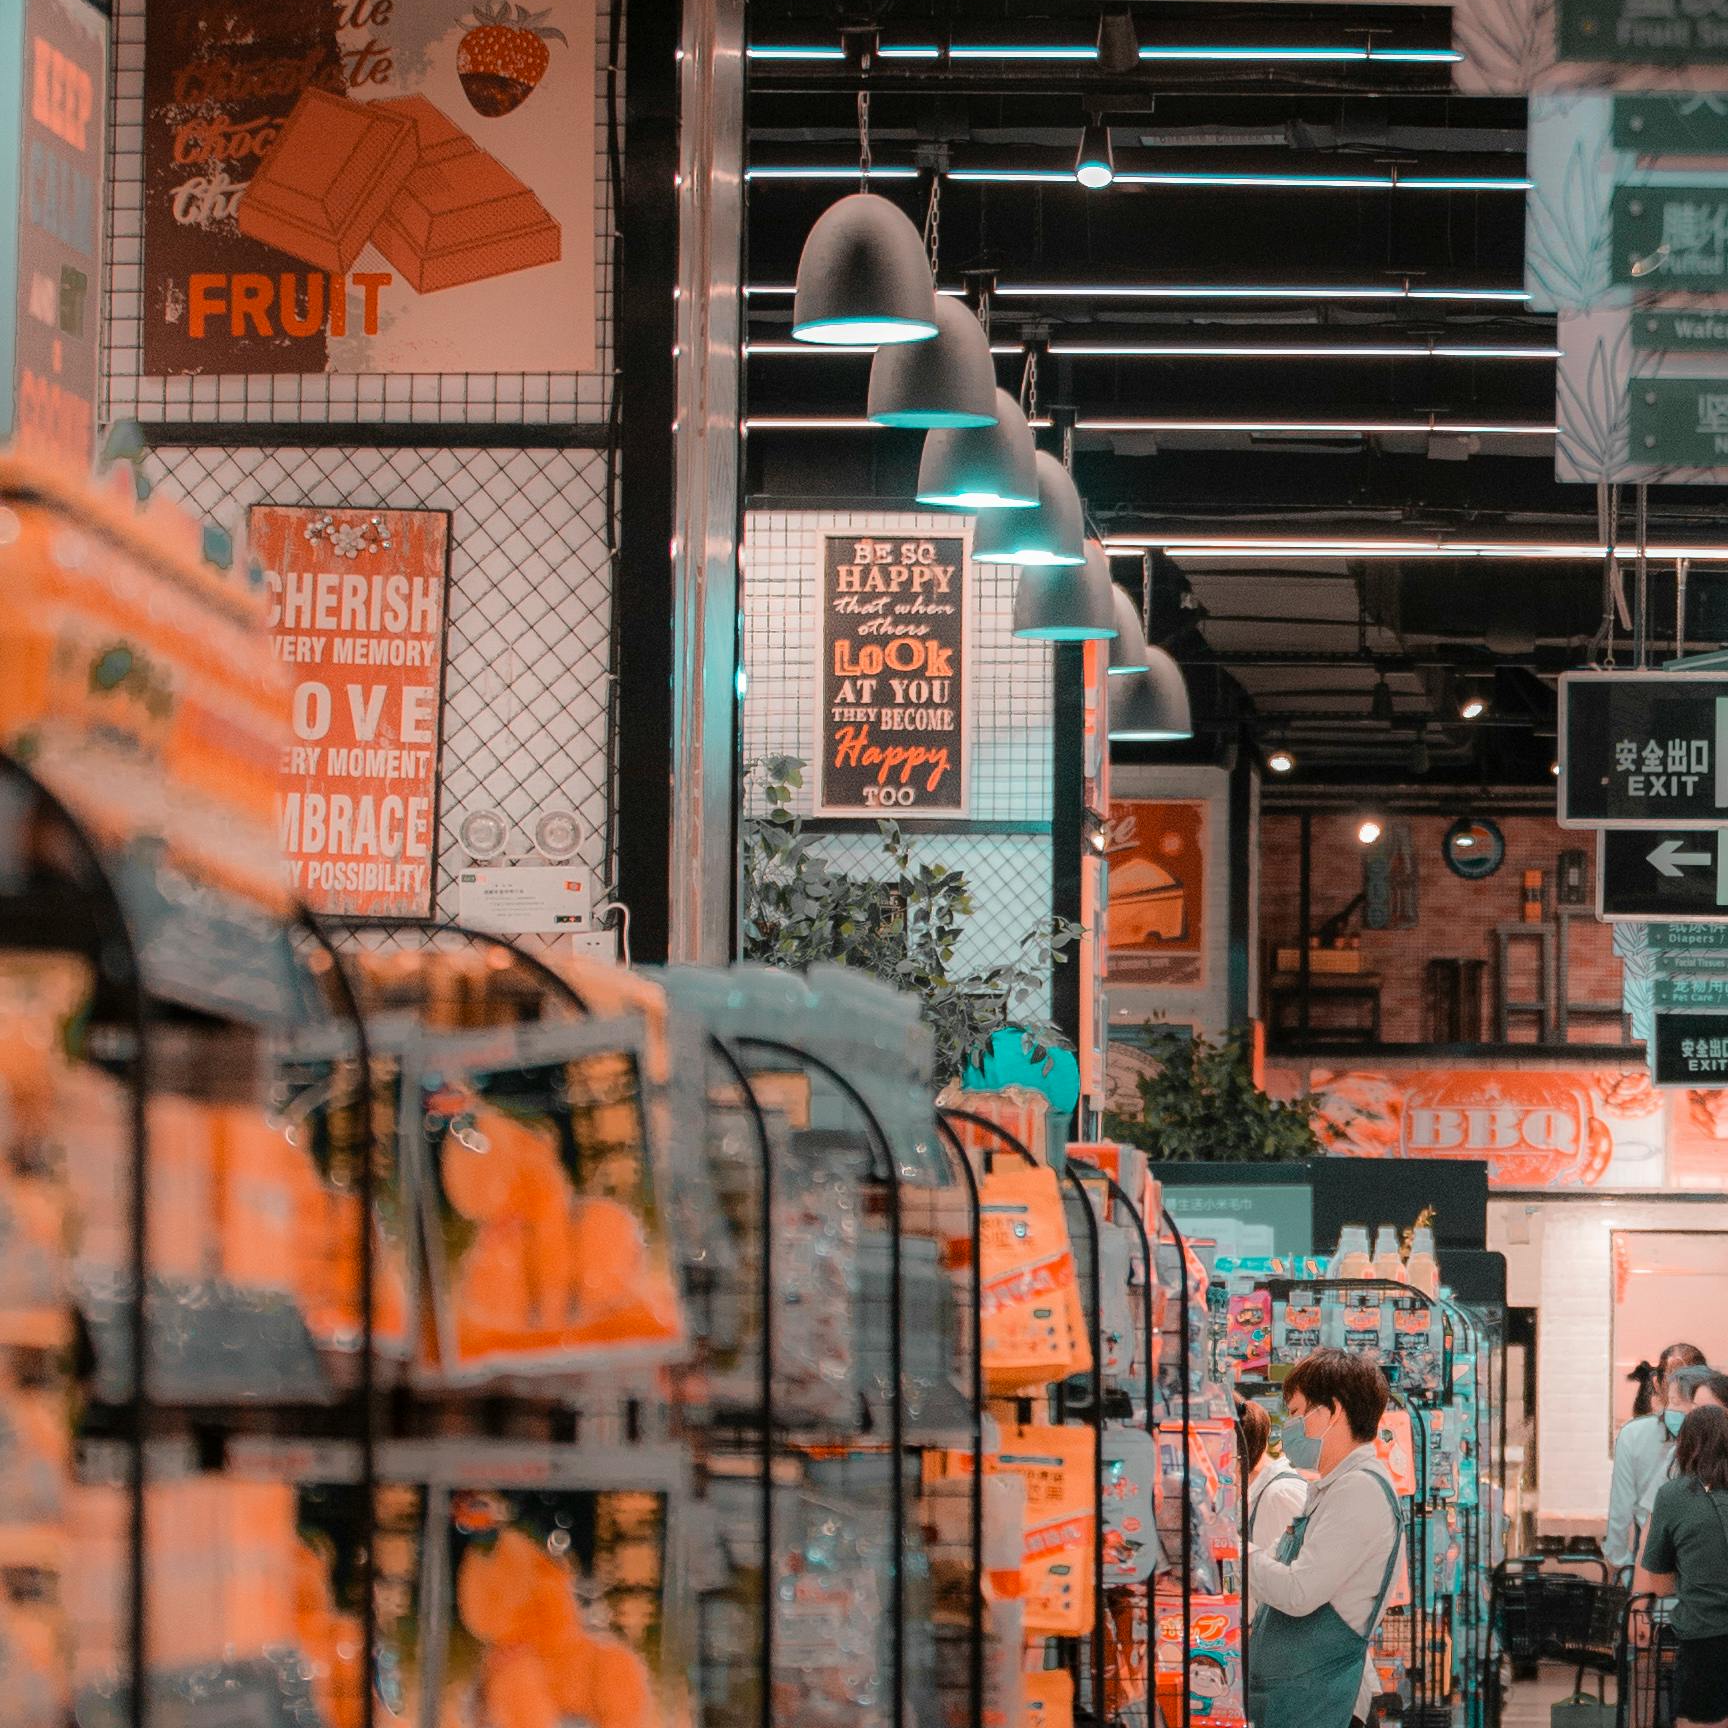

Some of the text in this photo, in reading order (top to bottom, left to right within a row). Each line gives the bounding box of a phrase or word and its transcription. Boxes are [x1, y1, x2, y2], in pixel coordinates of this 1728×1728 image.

[188, 273, 392, 338] FRUIT
[854, 543, 936, 565] BE SO
[836, 565, 955, 593] HAPPY
[264, 571, 439, 634] CHERISH
[832, 596, 955, 616] that when
[857, 617, 930, 637] others
[270, 636, 435, 667] VERY MEMORY
[834, 680, 950, 704] AT YOU
[292, 681, 433, 743] OVE
[831, 708, 954, 731] THEY BECOME
[280, 747, 431, 779] ERY MOMENT
[834, 724, 950, 792] Happy
[1614, 738, 1709, 774] 安全出口
[863, 786, 915, 806] TOO
[1627, 776, 1699, 797] EXIT
[277, 792, 430, 859] MBRACE
[306, 860, 426, 894] POSSIBILITY
[1668, 934, 1715, 945] Diapers
[1675, 958, 1696, 968] Facial
[1700, 959, 1726, 968] Tissues
[1672, 993, 1689, 1002] Pet
[1692, 994, 1713, 1002] Care
[1688, 1060, 1728, 1071] EXIT
[1409, 1108, 1578, 1154] BBQ
